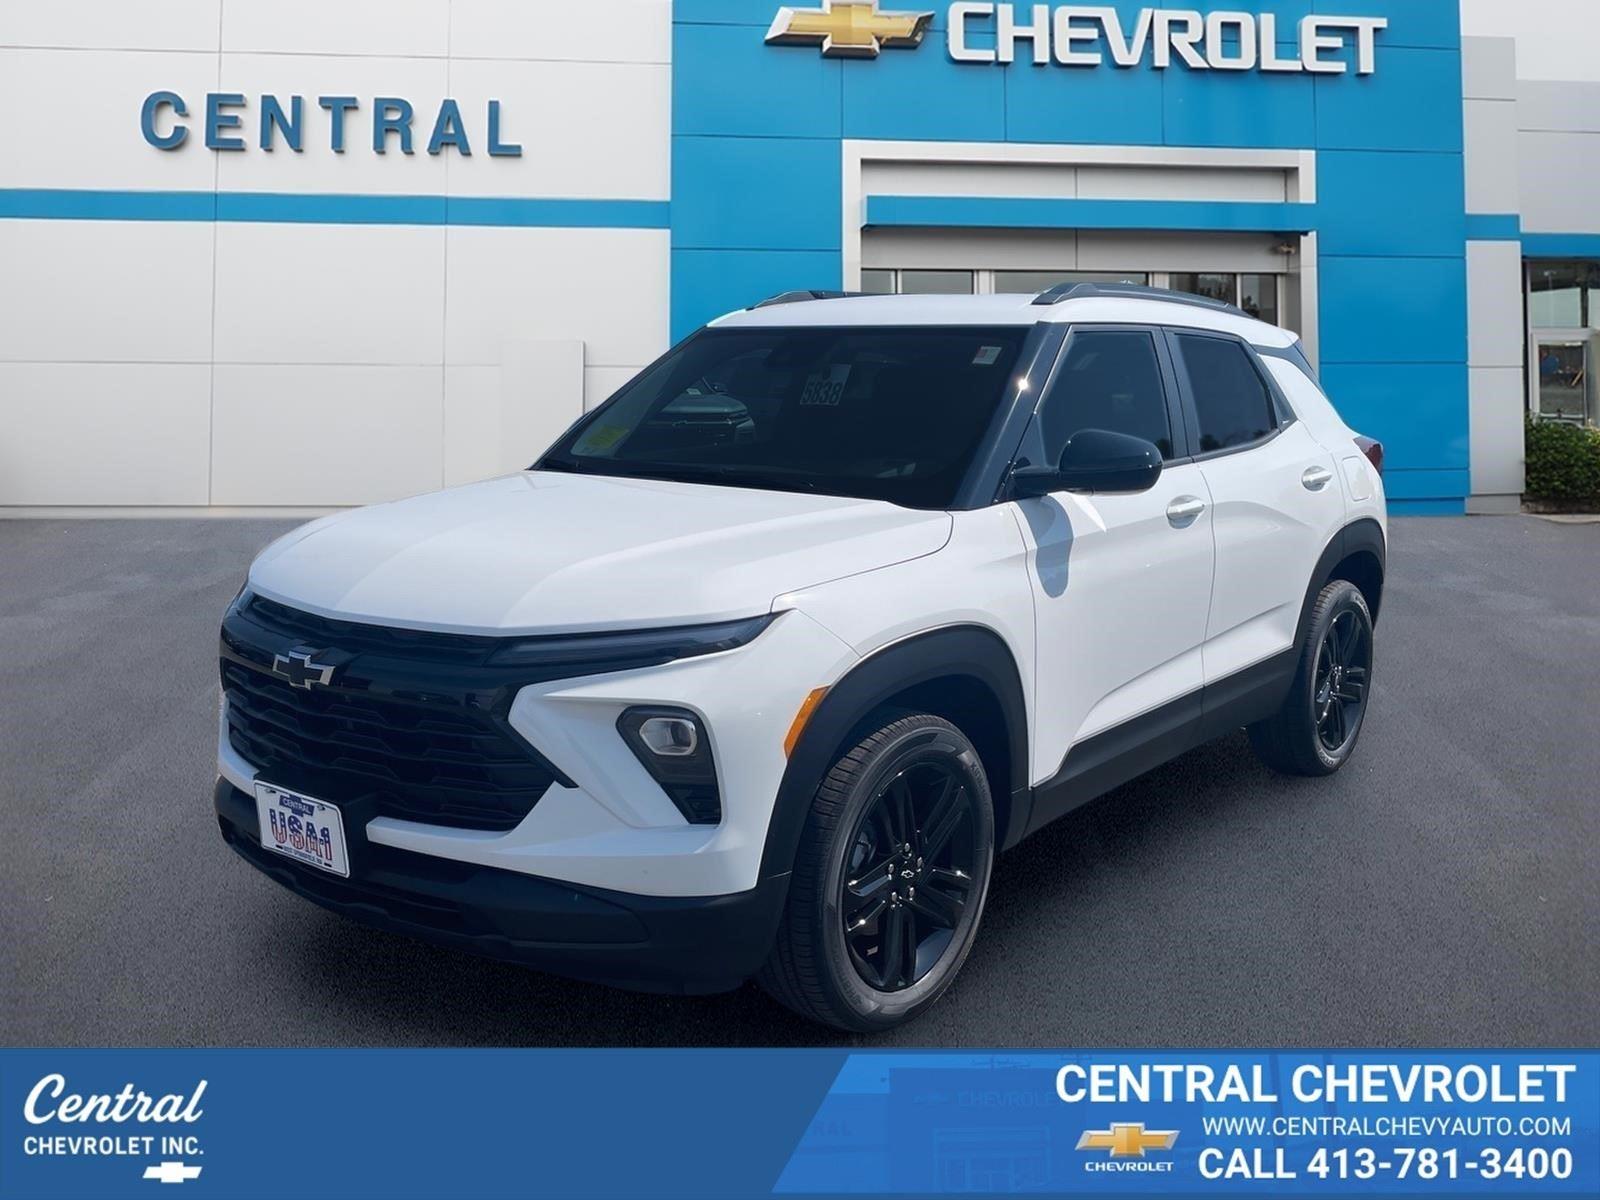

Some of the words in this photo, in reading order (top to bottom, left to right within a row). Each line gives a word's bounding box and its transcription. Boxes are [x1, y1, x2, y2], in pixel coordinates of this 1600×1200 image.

[947, 1, 1388, 75] CHEVROLET
[140, 90, 523, 158] CENTRAL
[802, 381, 844, 404] 5838
